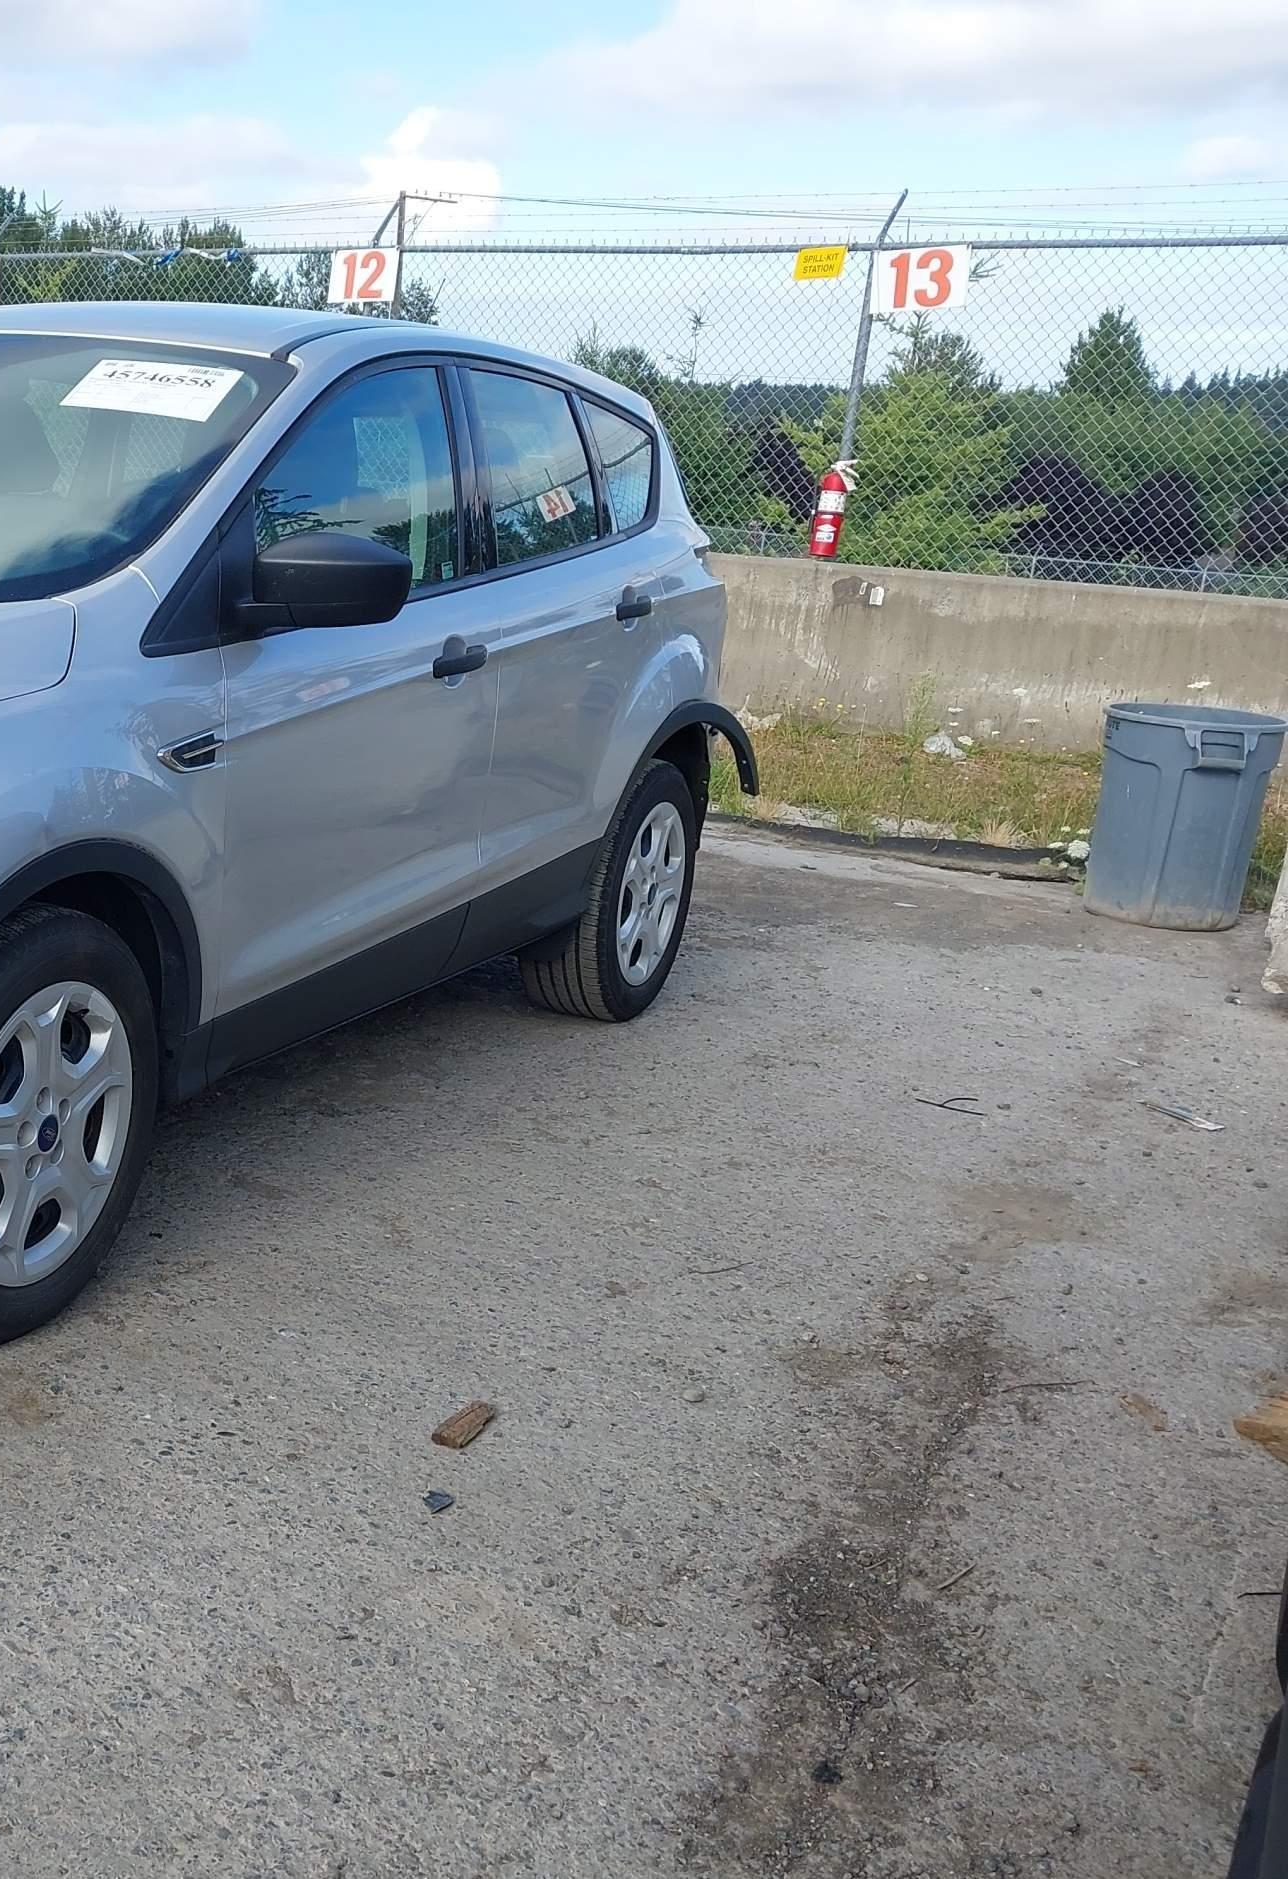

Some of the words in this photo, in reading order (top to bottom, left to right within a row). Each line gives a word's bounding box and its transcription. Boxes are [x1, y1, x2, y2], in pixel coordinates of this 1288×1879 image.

[802, 253, 840, 263] SPILL-KIT
[343, 250, 386, 299] 12
[802, 264, 834, 273] STATION
[890, 249, 954, 309] 13
[103, 369, 216, 388] 45746558
